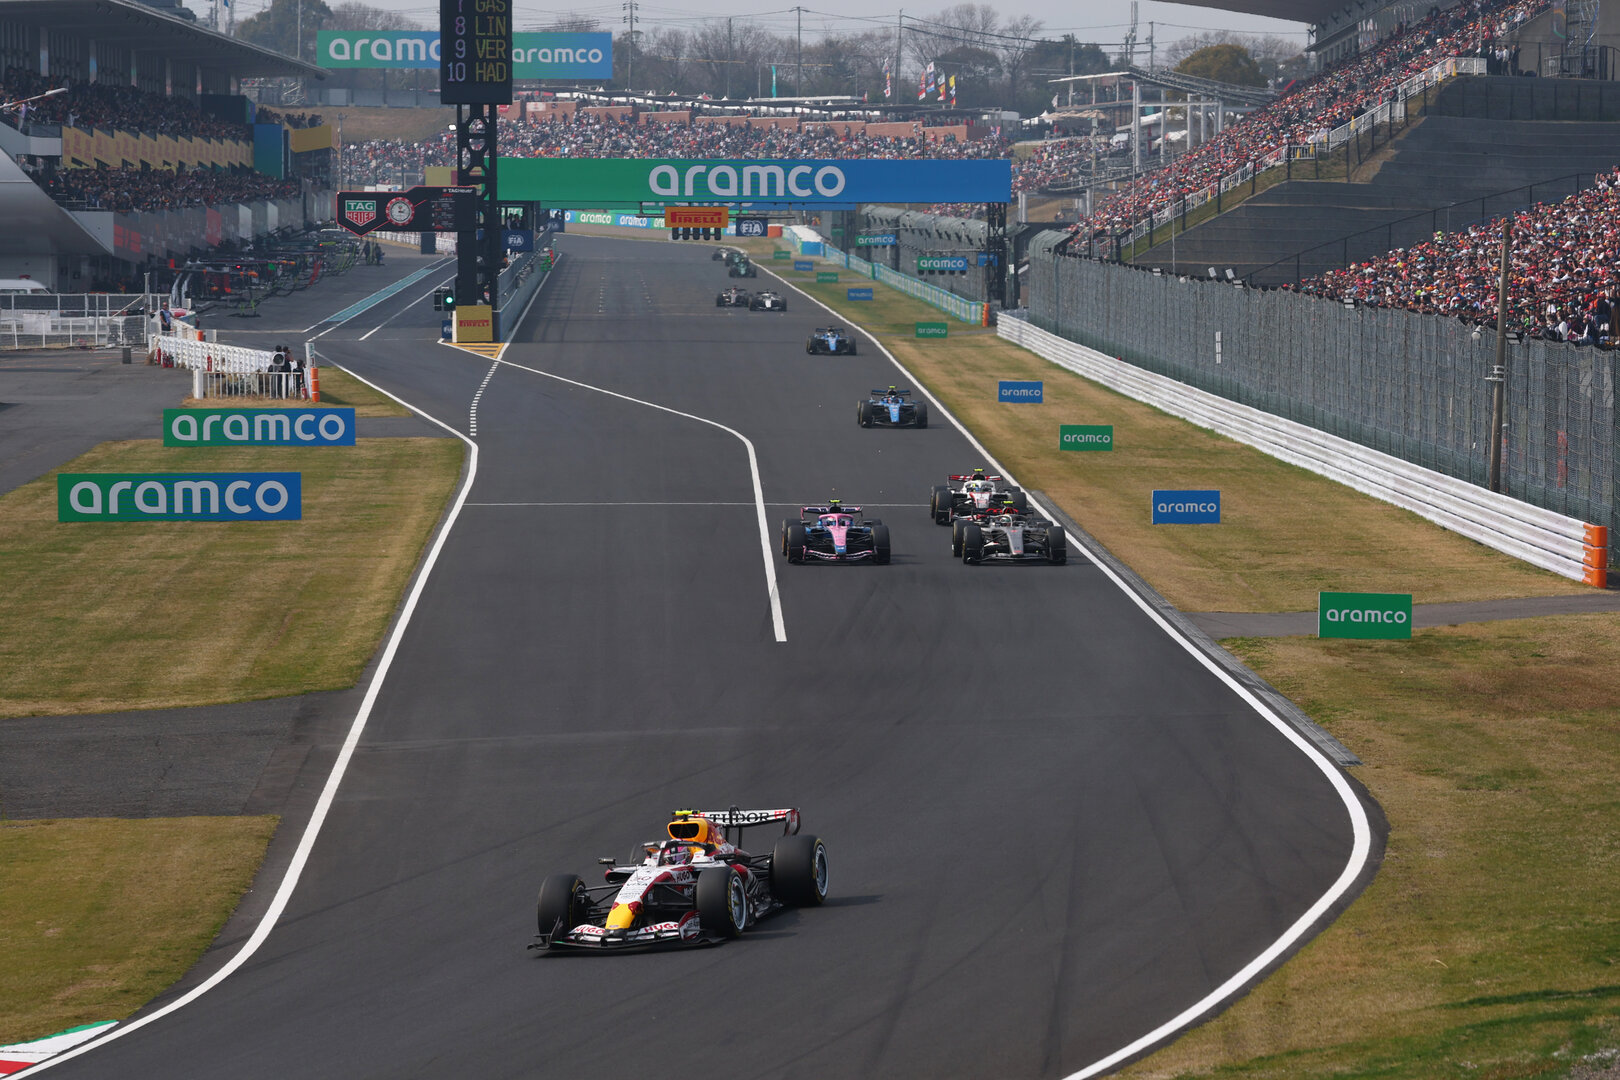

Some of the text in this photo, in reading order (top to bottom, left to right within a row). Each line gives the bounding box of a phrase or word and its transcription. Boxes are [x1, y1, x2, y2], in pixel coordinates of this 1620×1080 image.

[475, 0, 506, 13] GAS
[455, 16, 506, 36] 8 LIN
[329, 38, 440, 62] aramc
[455, 39, 507, 59] 9 VER
[512, 48, 603, 63] aramco
[447, 62, 507, 82] 10 HAD
[649, 164, 846, 198] aramco
[348, 202, 374, 211] TAG
[347, 211, 374, 223] HEUER
[580, 213, 612, 225] aramco
[671, 211, 722, 224] PIRELLI
[742, 223, 763, 234] FIA
[858, 236, 894, 244] aramco
[920, 258, 965, 268] aramco
[1001, 387, 1041, 397] aramco
[171, 414, 345, 441] aramco
[1063, 433, 1111, 444] aramco
[69, 480, 289, 514] aramco
[1157, 502, 1217, 513] aramco
[1326, 607, 1407, 624] aramco
